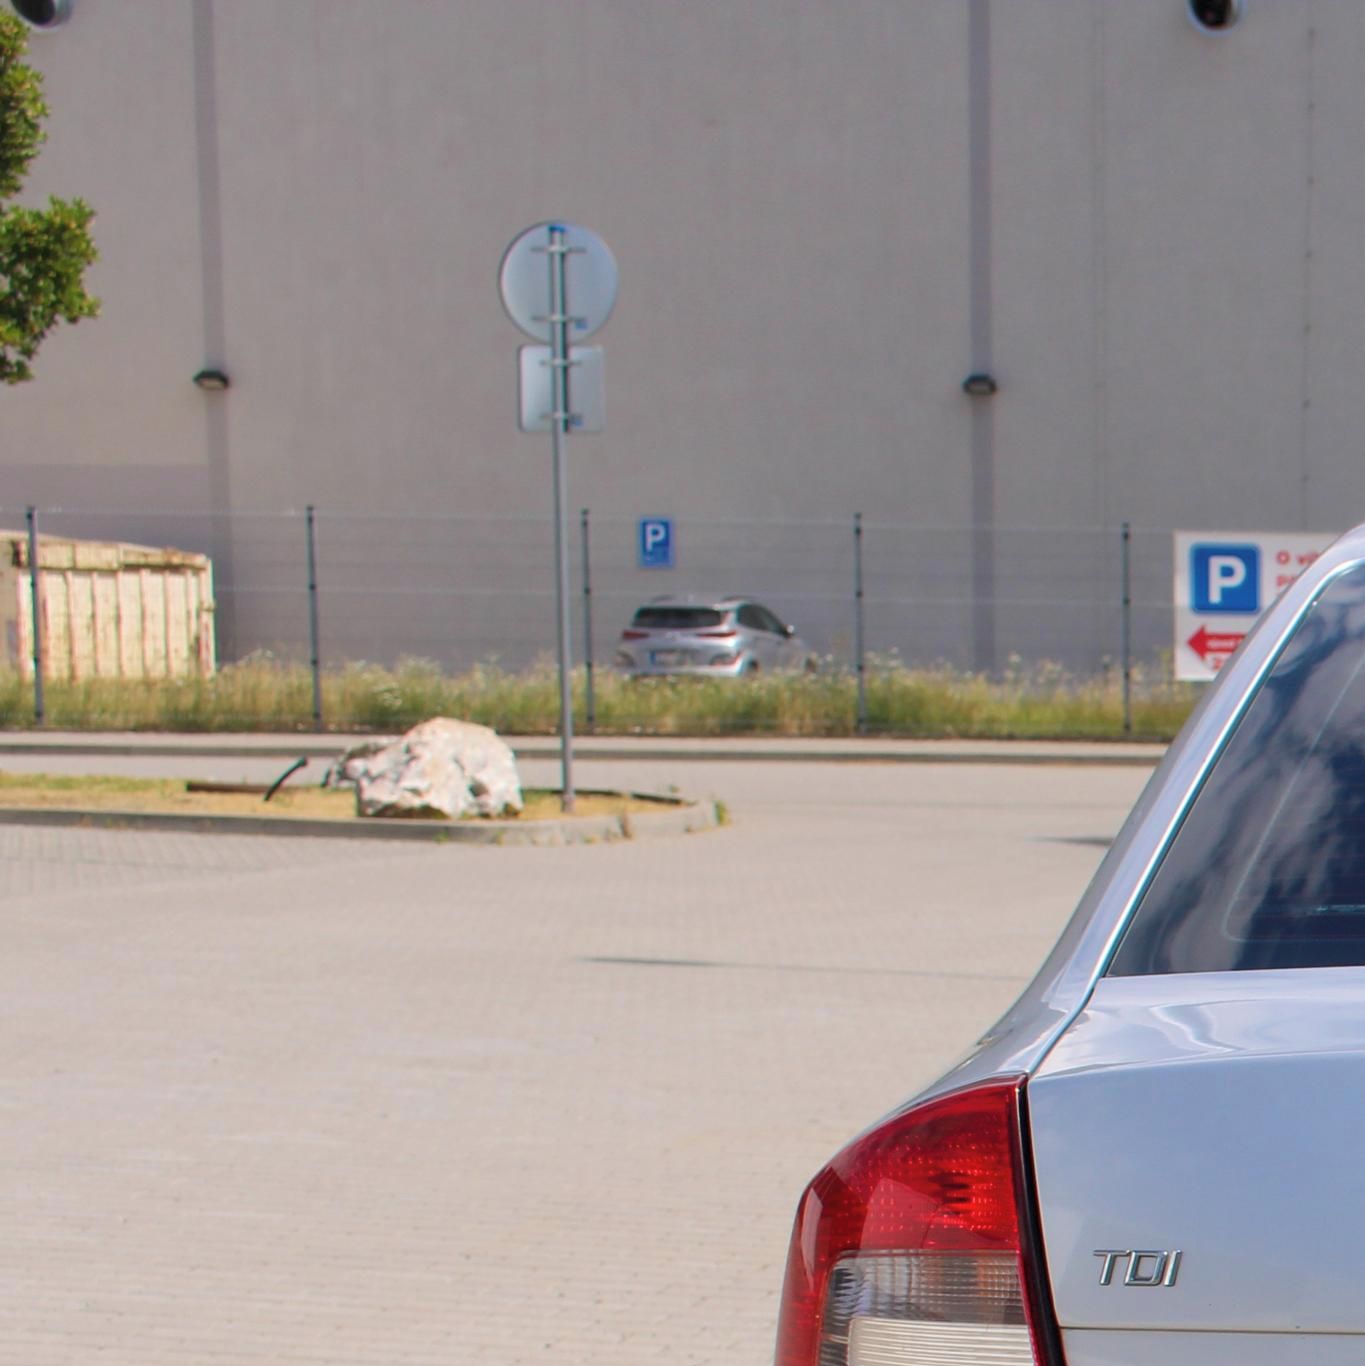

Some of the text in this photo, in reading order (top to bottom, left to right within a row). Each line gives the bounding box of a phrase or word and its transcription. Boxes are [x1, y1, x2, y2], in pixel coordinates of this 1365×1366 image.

[646, 524, 666, 550] P
[1208, 556, 1246, 604] P
[1093, 1249, 1182, 1287] TDI
